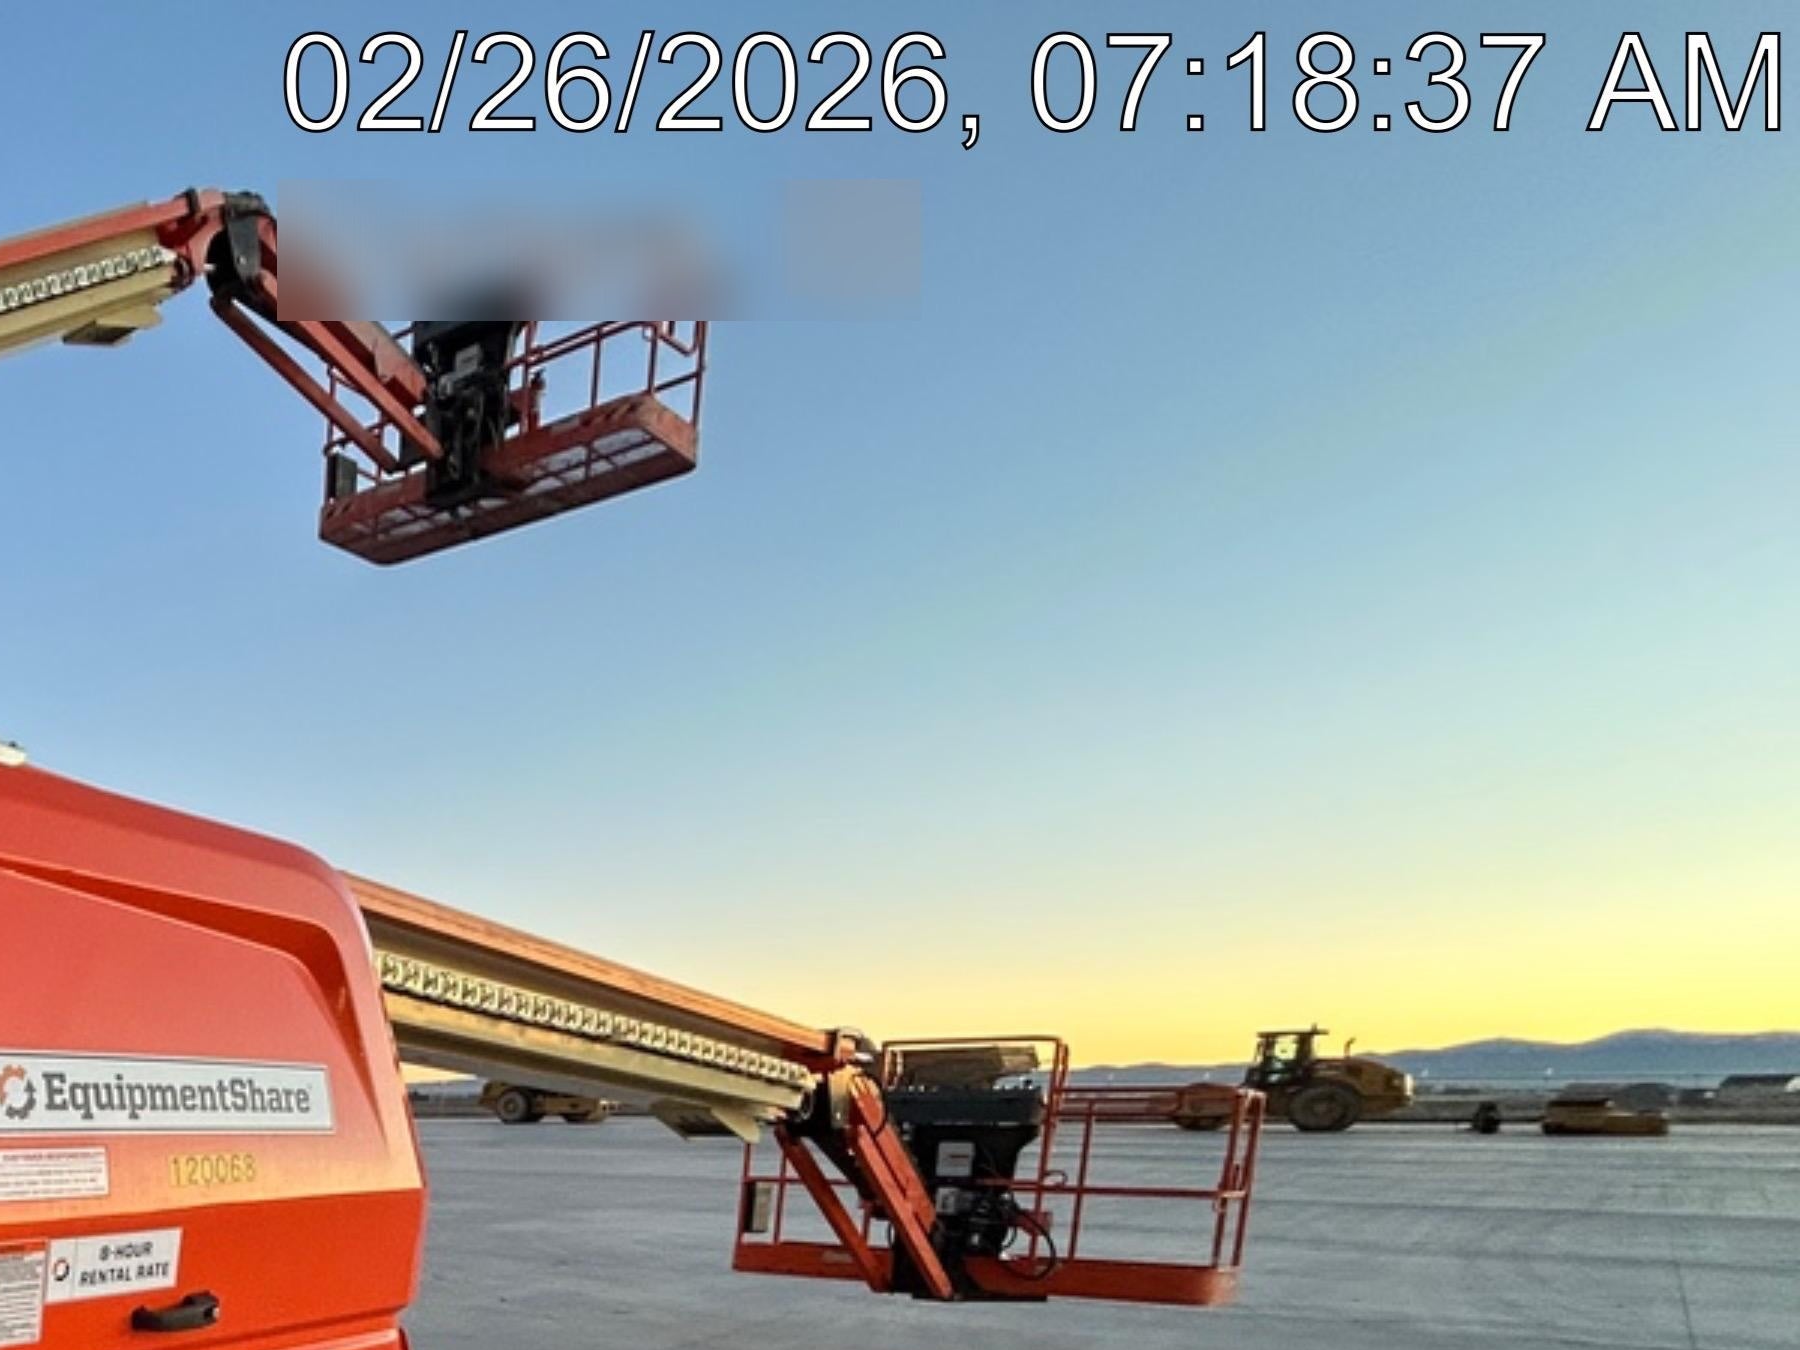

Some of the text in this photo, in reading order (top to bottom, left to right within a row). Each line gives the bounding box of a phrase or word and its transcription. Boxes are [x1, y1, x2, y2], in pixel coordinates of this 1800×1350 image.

[42, 1072, 311, 1120] EquipmentShare
[171, 1153, 256, 1187] 120068
[79, 1261, 171, 1286] RENTAL RATE
